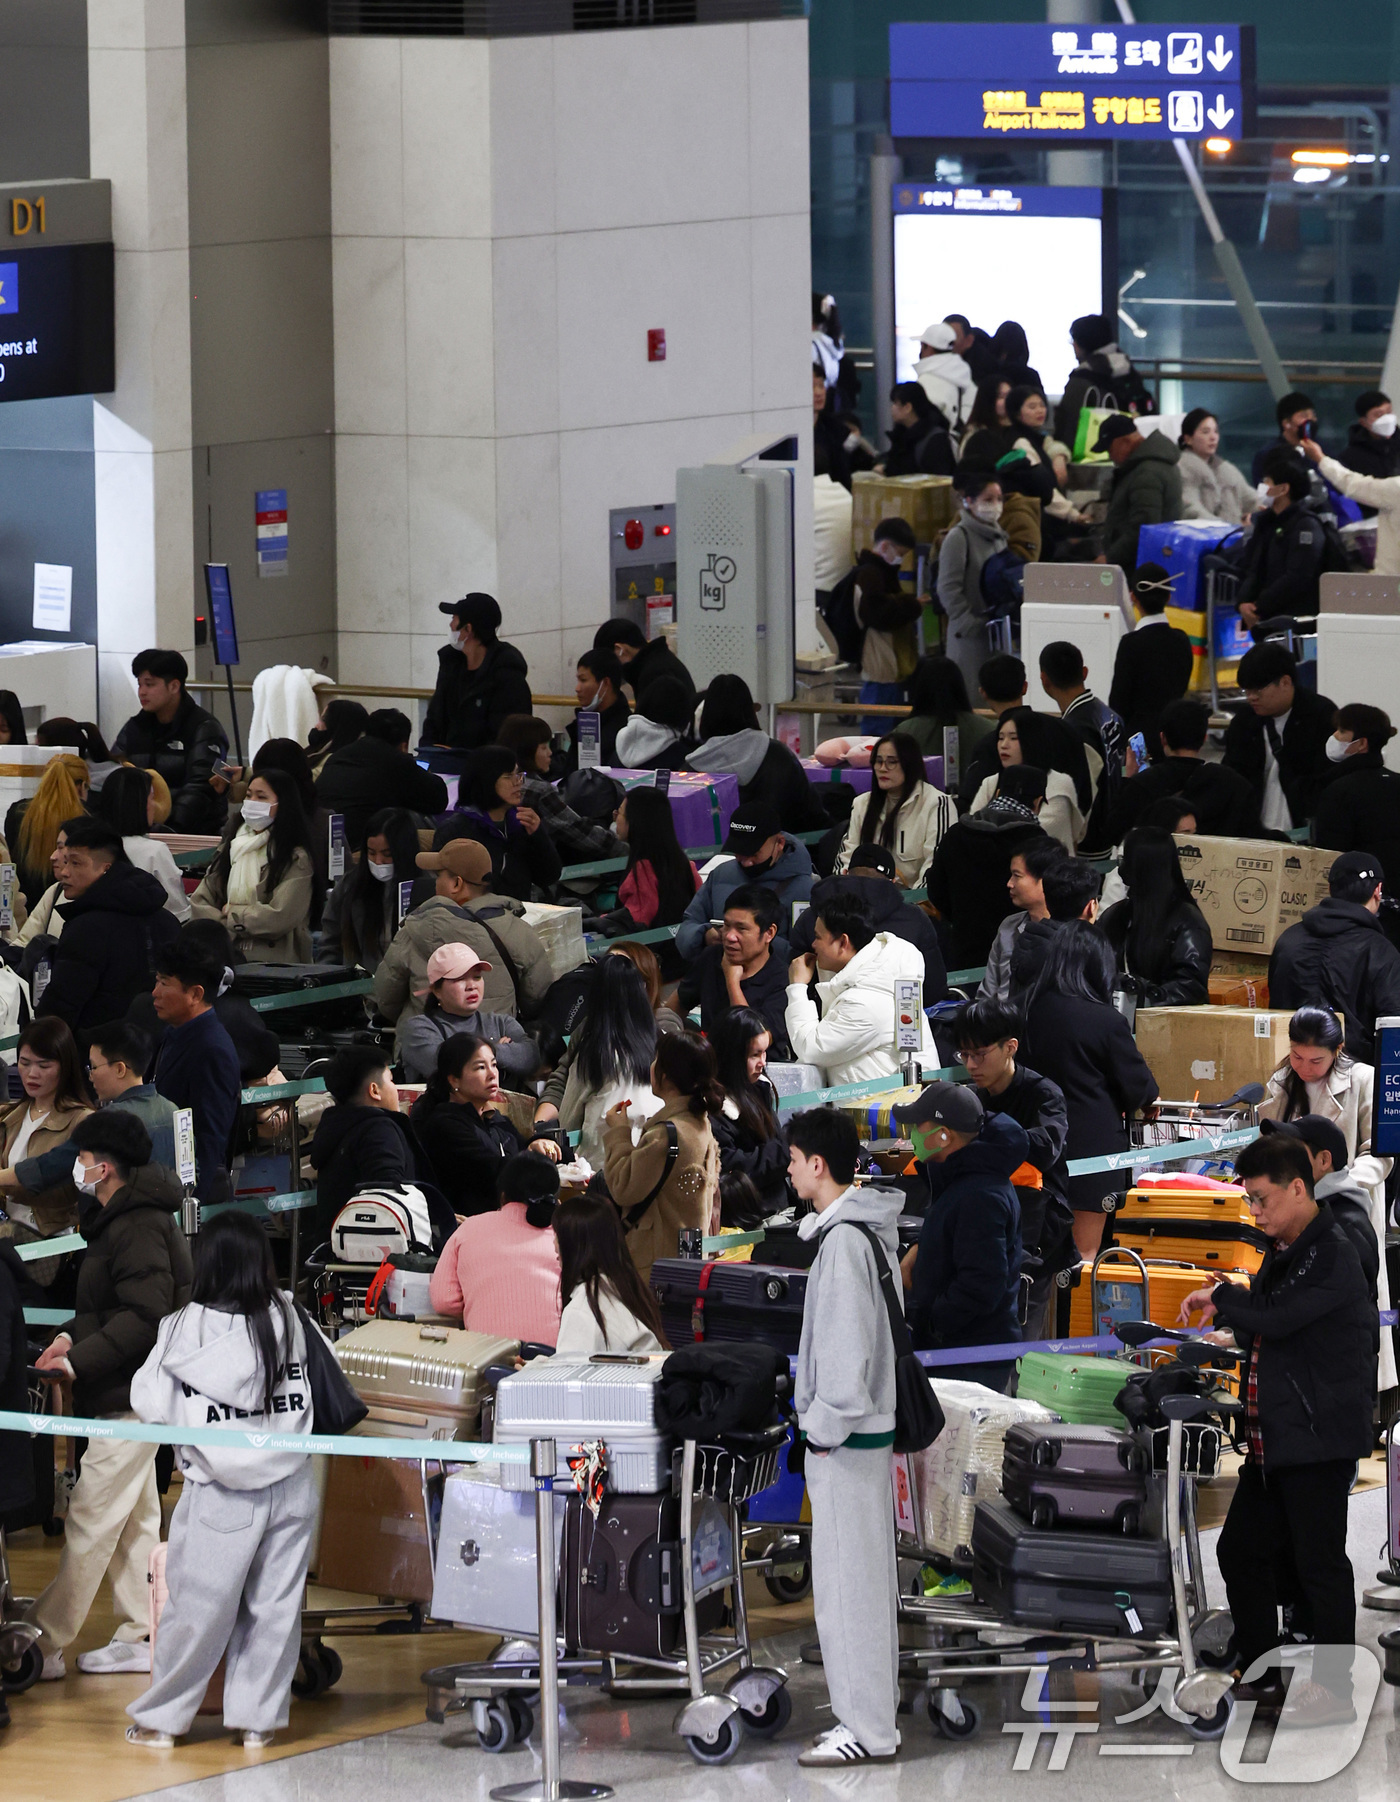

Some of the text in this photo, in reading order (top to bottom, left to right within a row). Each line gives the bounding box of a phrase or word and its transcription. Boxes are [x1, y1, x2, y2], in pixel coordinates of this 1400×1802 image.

[13, 197, 45, 235] D1
[26, 337, 38, 354] at
[704, 584, 721, 601] kg
[1281, 891, 1307, 906] CLASIC
[851, 1087, 869, 1096] Airport
[51, 1422, 114, 1436] Incheon Airport
[270, 1439, 334, 1451] Incheon Airport
[492, 1450, 525, 1460] Incheon
